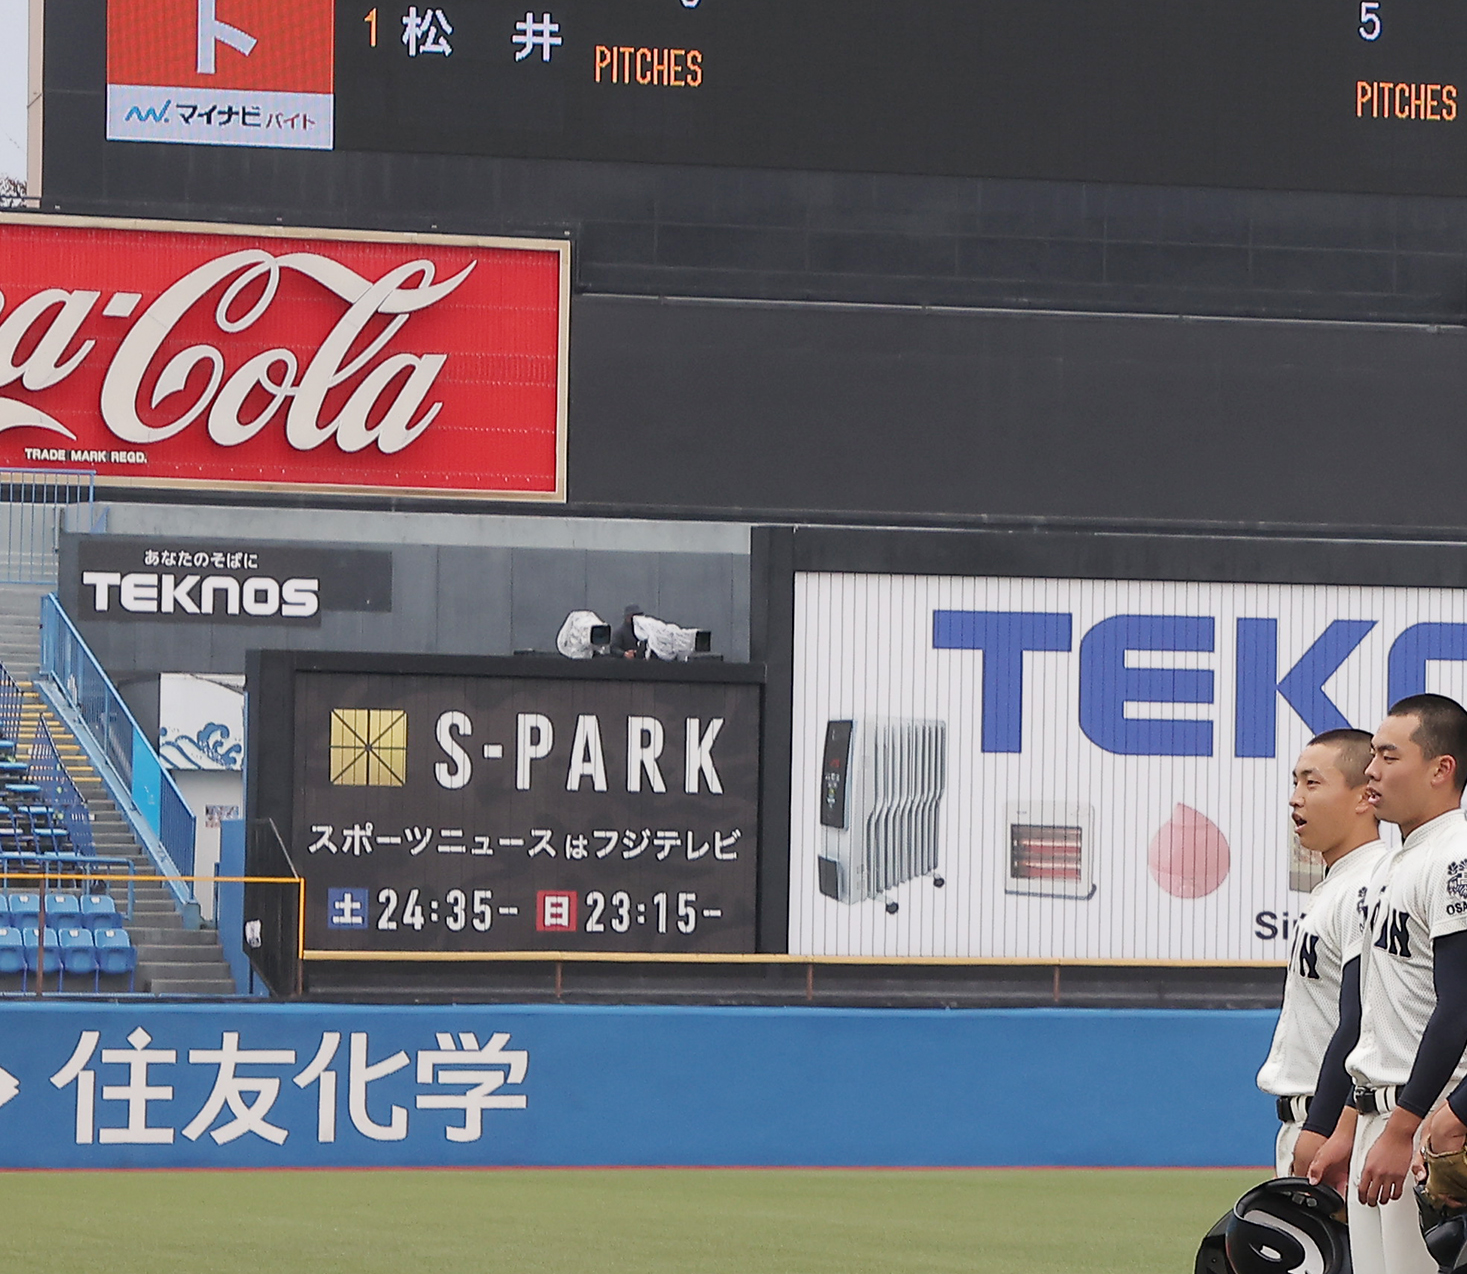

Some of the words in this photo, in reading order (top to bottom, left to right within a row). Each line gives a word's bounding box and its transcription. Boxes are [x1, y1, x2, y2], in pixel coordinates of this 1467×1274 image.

[365, 8, 376, 46] 1
[403, 7, 561, 61] 松井
[1360, 2, 1380, 40] 5
[596, 46, 702, 86] PITCHES
[176, 103, 262, 128] マイナビ
[265, 110, 316, 131] バイト
[1357, 81, 1456, 120] PITCHES
[0, 248, 478, 455] a-Cola
[25, 447, 66, 462] TRADE
[70, 449, 108, 464] MARK
[143, 548, 260, 570] あなたのそばに
[83, 572, 320, 618] TEKNOS
[434, 710, 726, 794] S-PARK
[308, 822, 742, 861] スポーツニュースはフジテレビ
[331, 892, 364, 925] 土
[543, 895, 570, 927] 日
[50, 1026, 529, 1145] 住友化学
